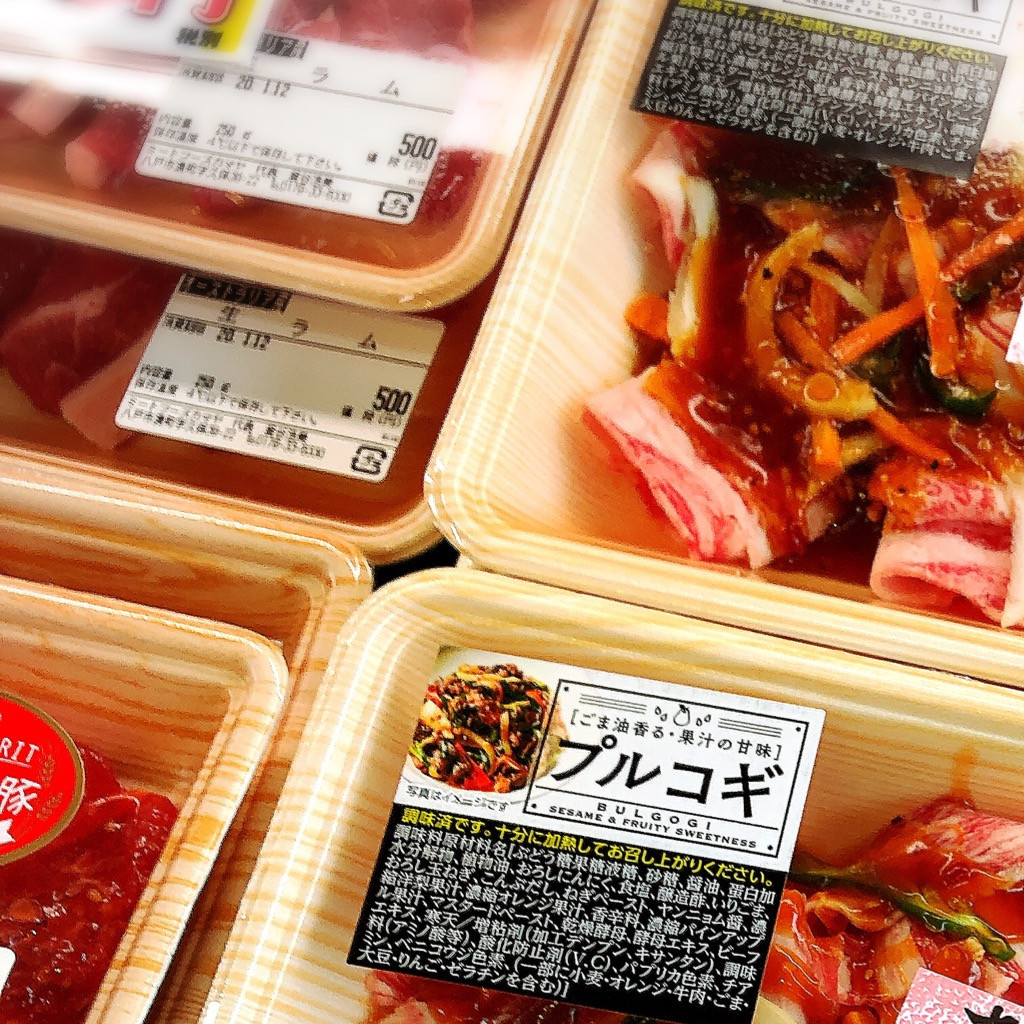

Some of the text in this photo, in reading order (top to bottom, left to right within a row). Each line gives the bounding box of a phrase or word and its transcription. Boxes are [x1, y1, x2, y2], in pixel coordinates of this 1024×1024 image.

[399, 133, 439, 160] 500
[373, 385, 413, 415] 500
[551, 735, 785, 818] プルコギ
[549, 806, 603, 825] SESAME
[623, 819, 670, 832] FRUITY
[676, 828, 756, 848] SWEETNESS
[598, 803, 710, 830] BULGOGI
[402, 808, 774, 886] 調味済です。十分に加熱してお召し上がりください。
